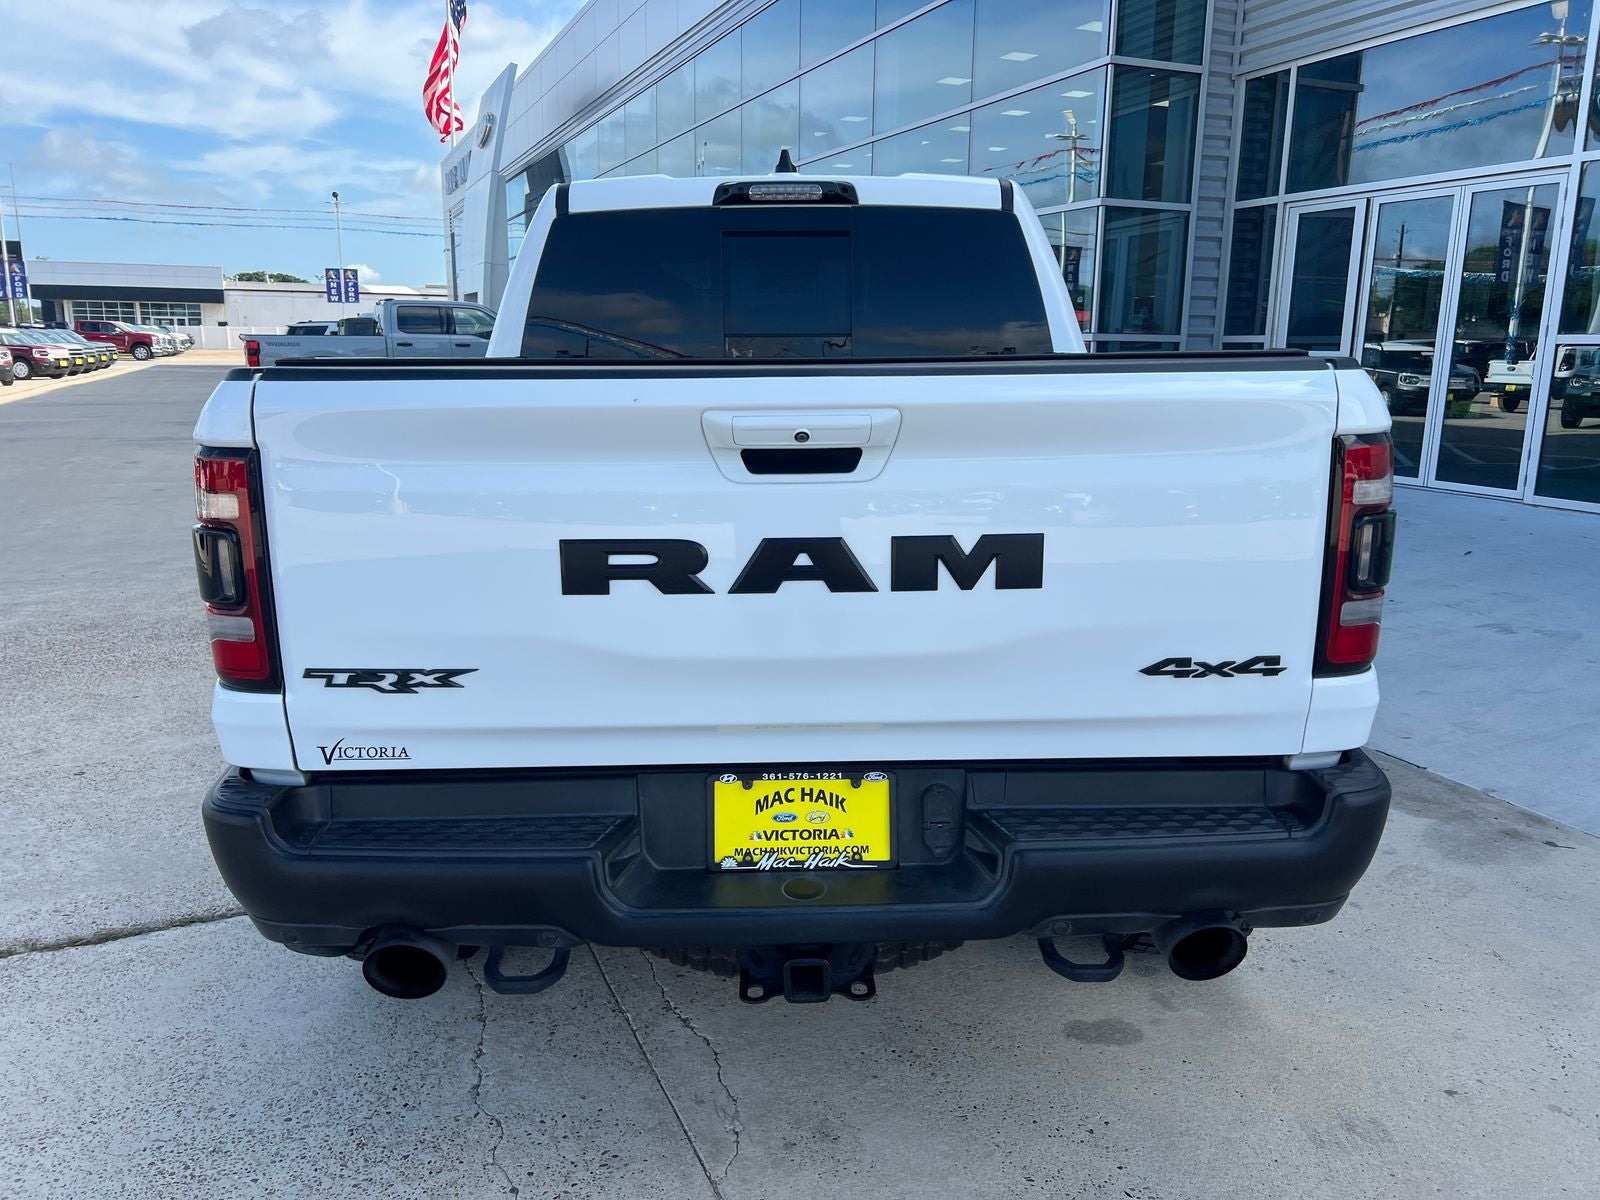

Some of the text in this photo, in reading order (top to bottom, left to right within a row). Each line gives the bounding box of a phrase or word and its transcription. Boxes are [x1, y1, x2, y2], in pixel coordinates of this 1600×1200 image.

[330, 282, 339, 302] NEW
[559, 533, 1045, 595] RAM
[302, 668, 479, 694] TRX
[762, 772, 843, 780] 361-576-1221
[755, 787, 847, 815] MAC HAIK
[763, 828, 841, 841] VICTORIA
[758, 851, 850, 870] Mac Haik
